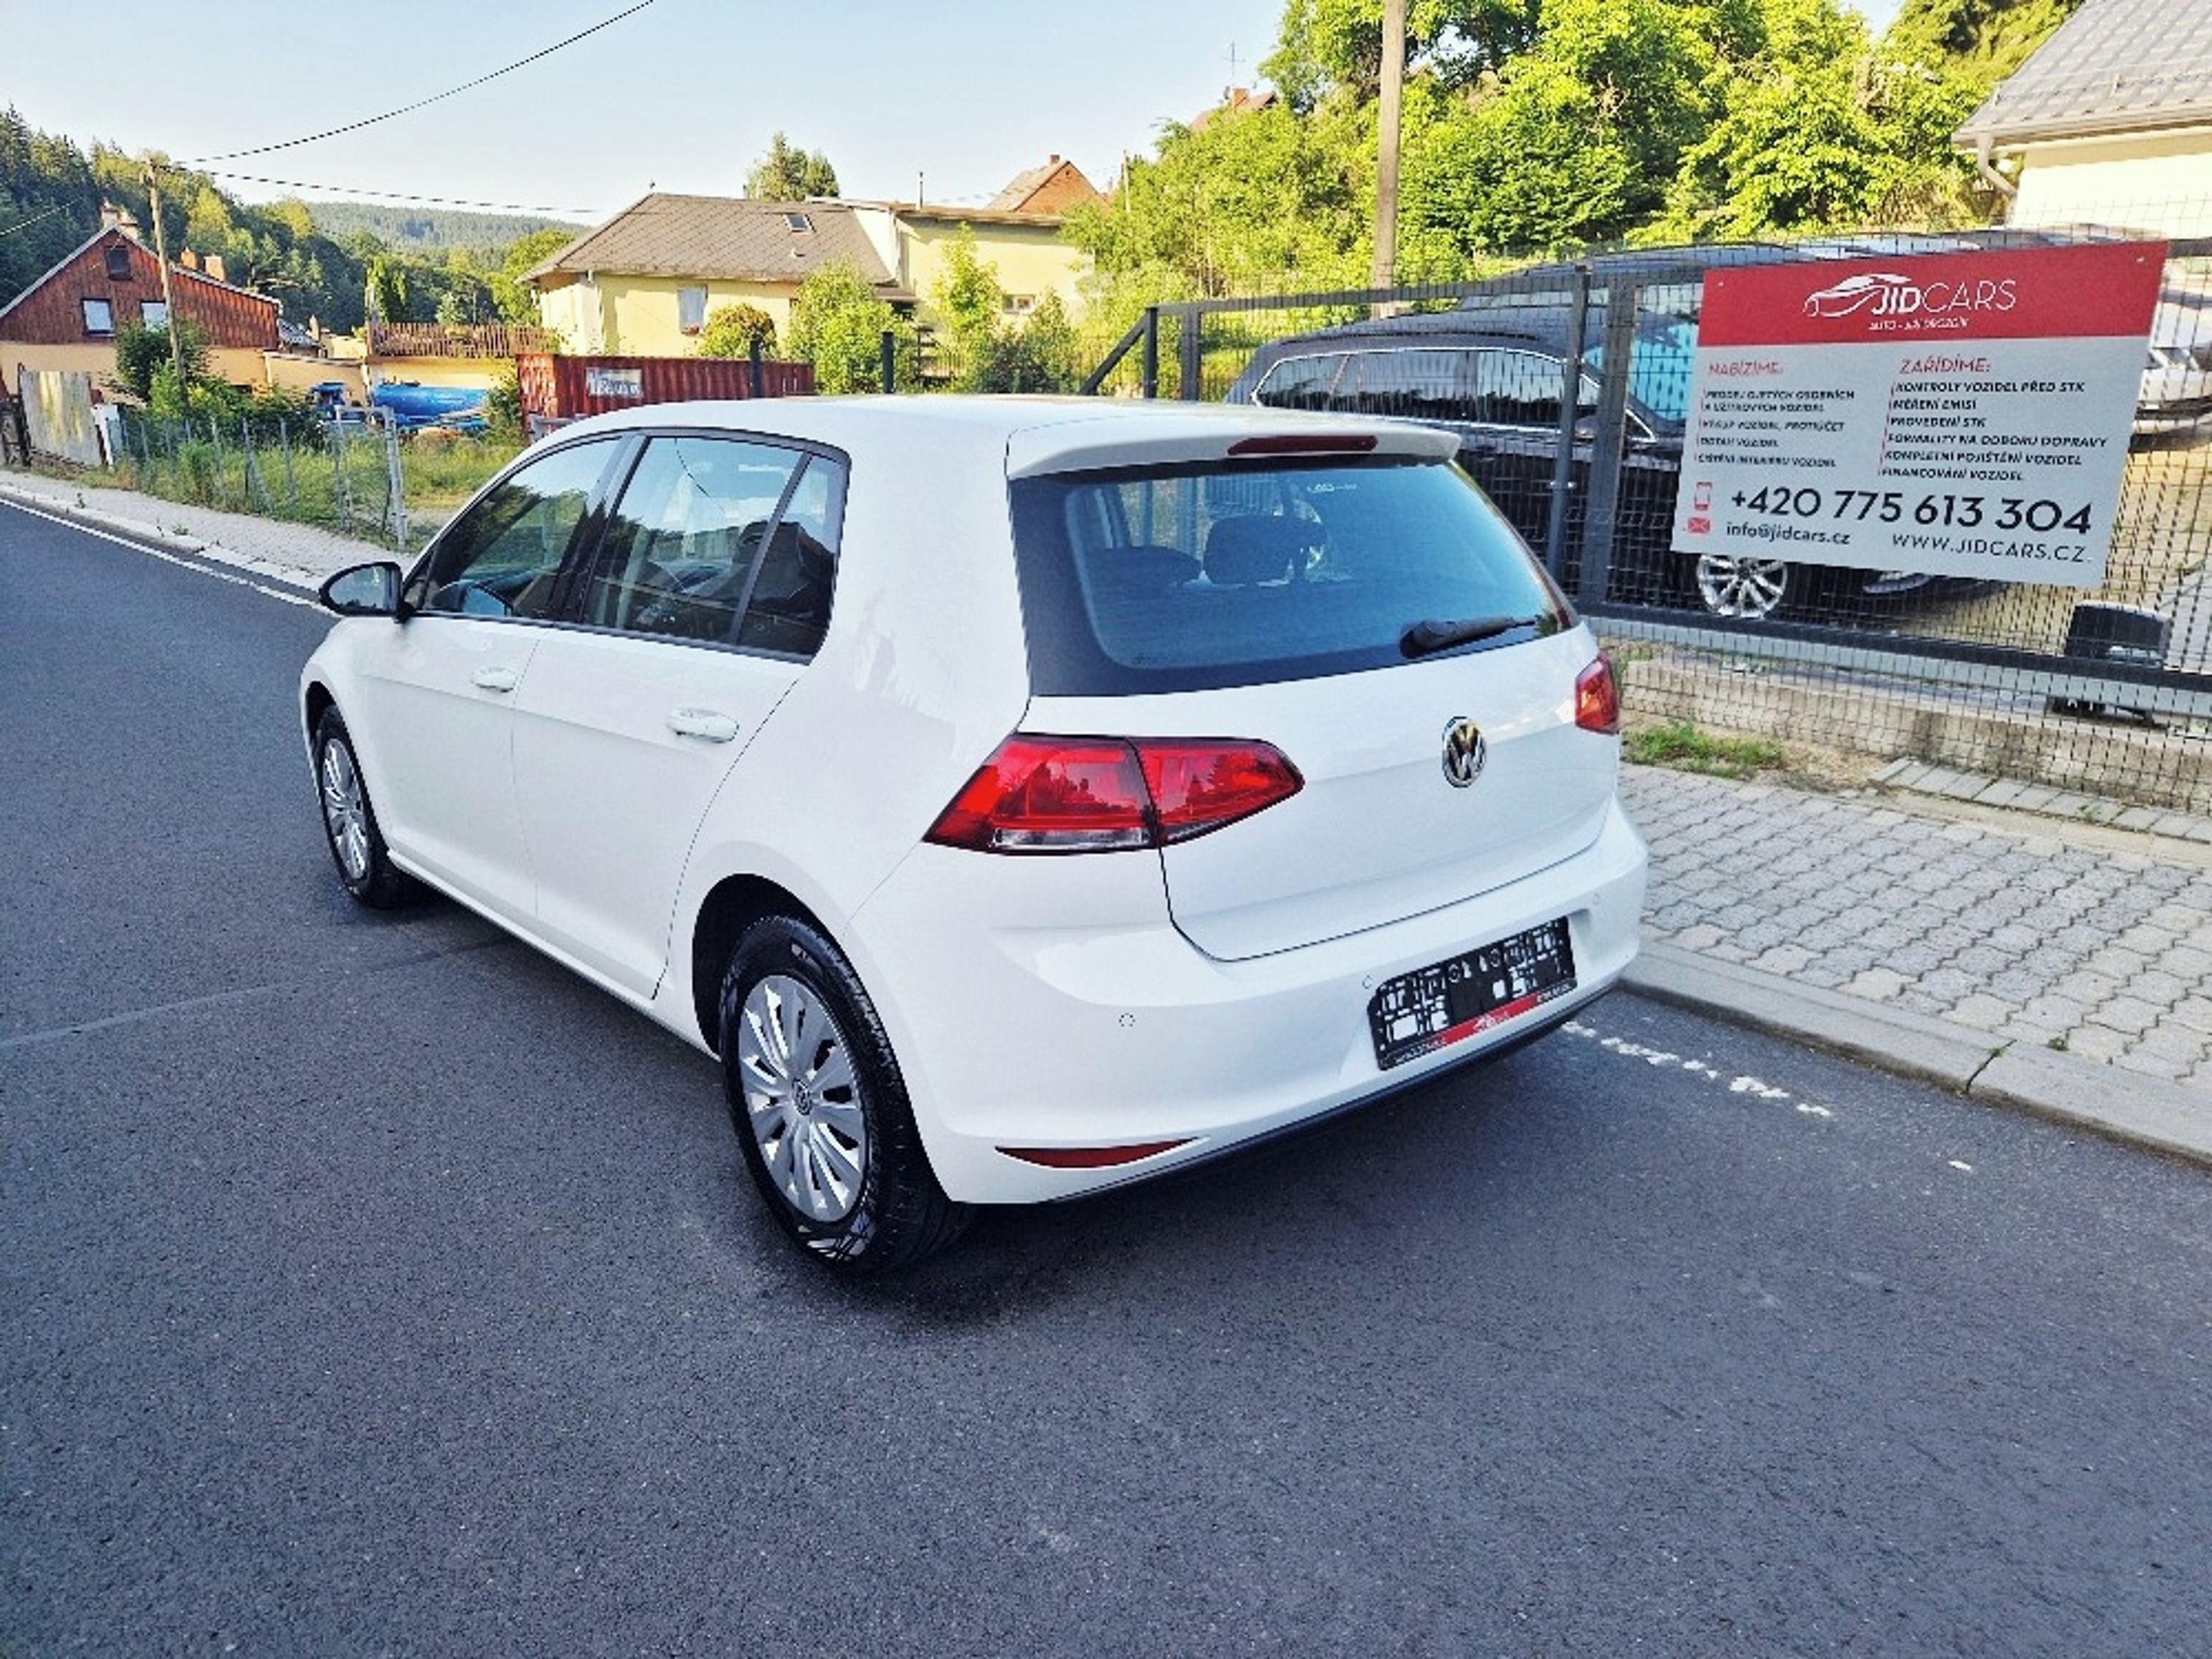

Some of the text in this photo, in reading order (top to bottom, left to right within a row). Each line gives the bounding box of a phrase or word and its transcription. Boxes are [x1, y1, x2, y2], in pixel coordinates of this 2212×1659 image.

[1871, 280, 2017, 315] JIDCARS
[1899, 354, 1992, 374] ZAŘÍDÍME:
[1895, 380, 2085, 392] KONTROLY VOZIDEL PŘED STK
[1893, 397, 1977, 410] MĚŘENÍ EMISÍ
[1890, 415, 1987, 428] PROVEDENÍ STK
[1888, 433, 1956, 443] FORMALITY
[1959, 434, 1976, 445] NA
[2041, 437, 2109, 448] DOPRAVY
[1884, 448, 2082, 465] KOMPLETNÍ POJIŠTĚNÍ VOZIDEL
[1882, 466, 2024, 481] FINANCOVÁNÍ VOZIDEL
[1731, 486, 2093, 535] +420 775 613 304
[1726, 521, 1851, 545] info@jidcars.cz
[1892, 533, 2087, 563] WWW.JIDCARS.CZ
